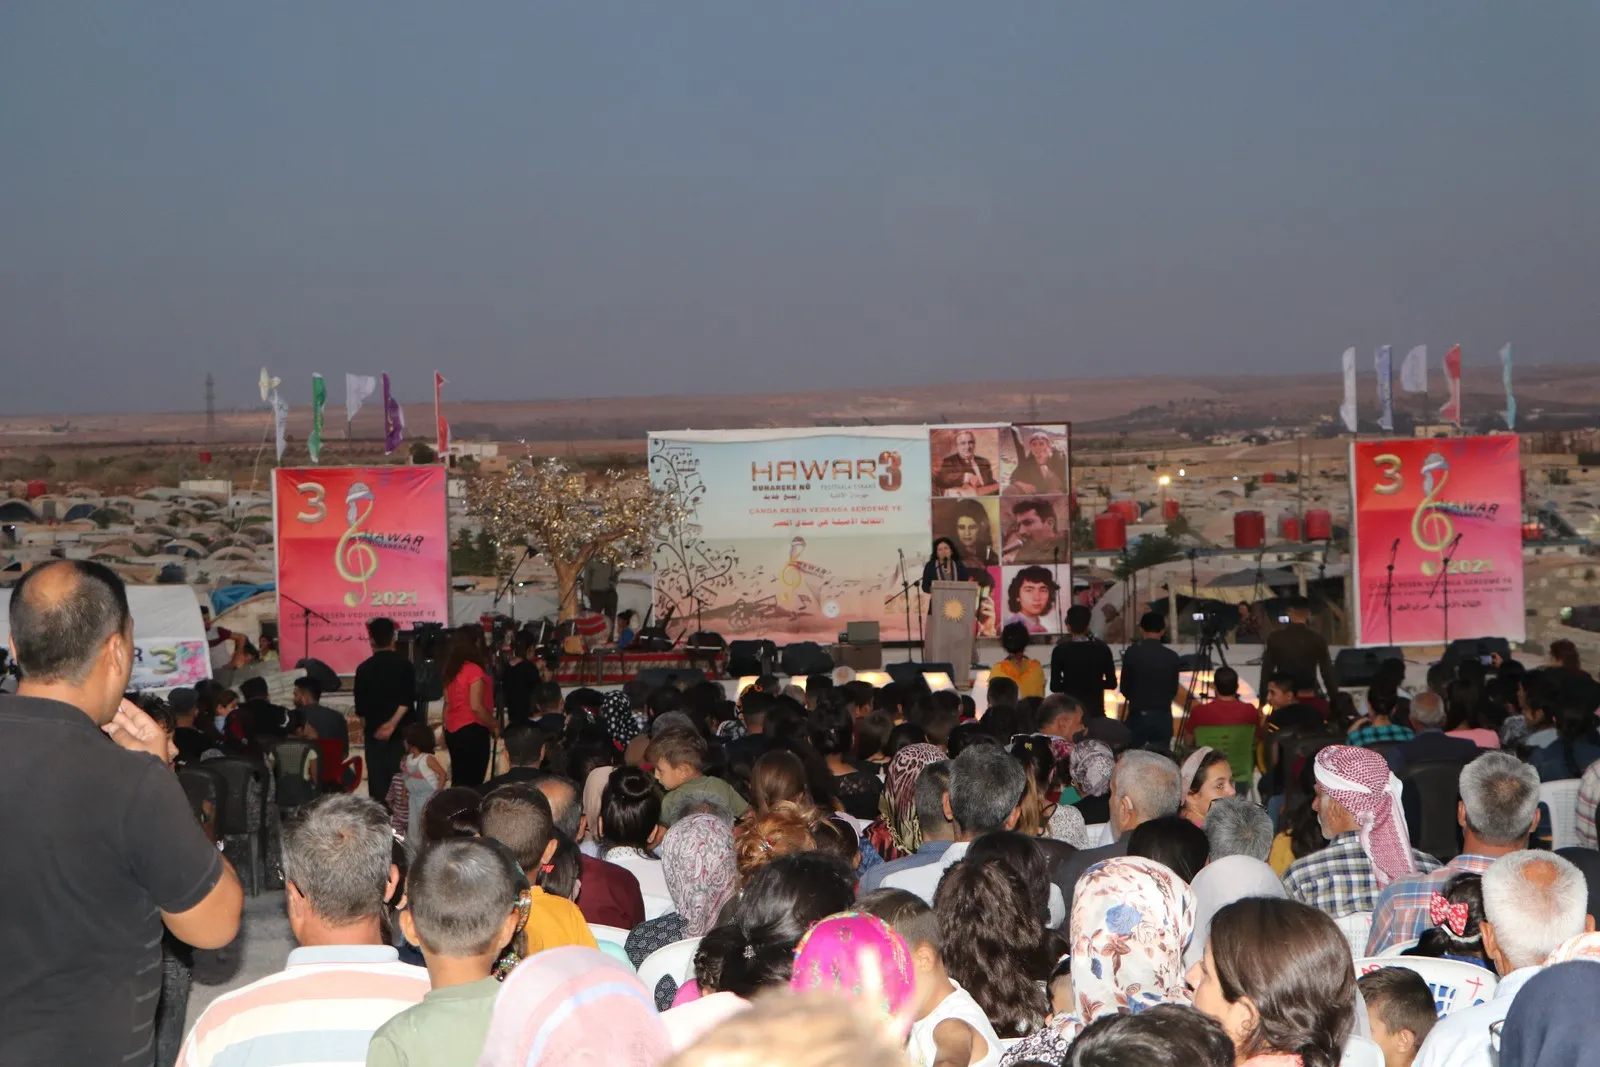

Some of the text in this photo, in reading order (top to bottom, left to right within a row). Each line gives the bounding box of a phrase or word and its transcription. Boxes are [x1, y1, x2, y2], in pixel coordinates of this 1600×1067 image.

[752, 451, 902, 492] HAWAR 3
[1373, 453, 1404, 495] 3
[296, 481, 327, 524] 3
[1446, 559, 1494, 576] 2021
[370, 589, 418, 608] 2021
[150, 647, 178, 675] 3
